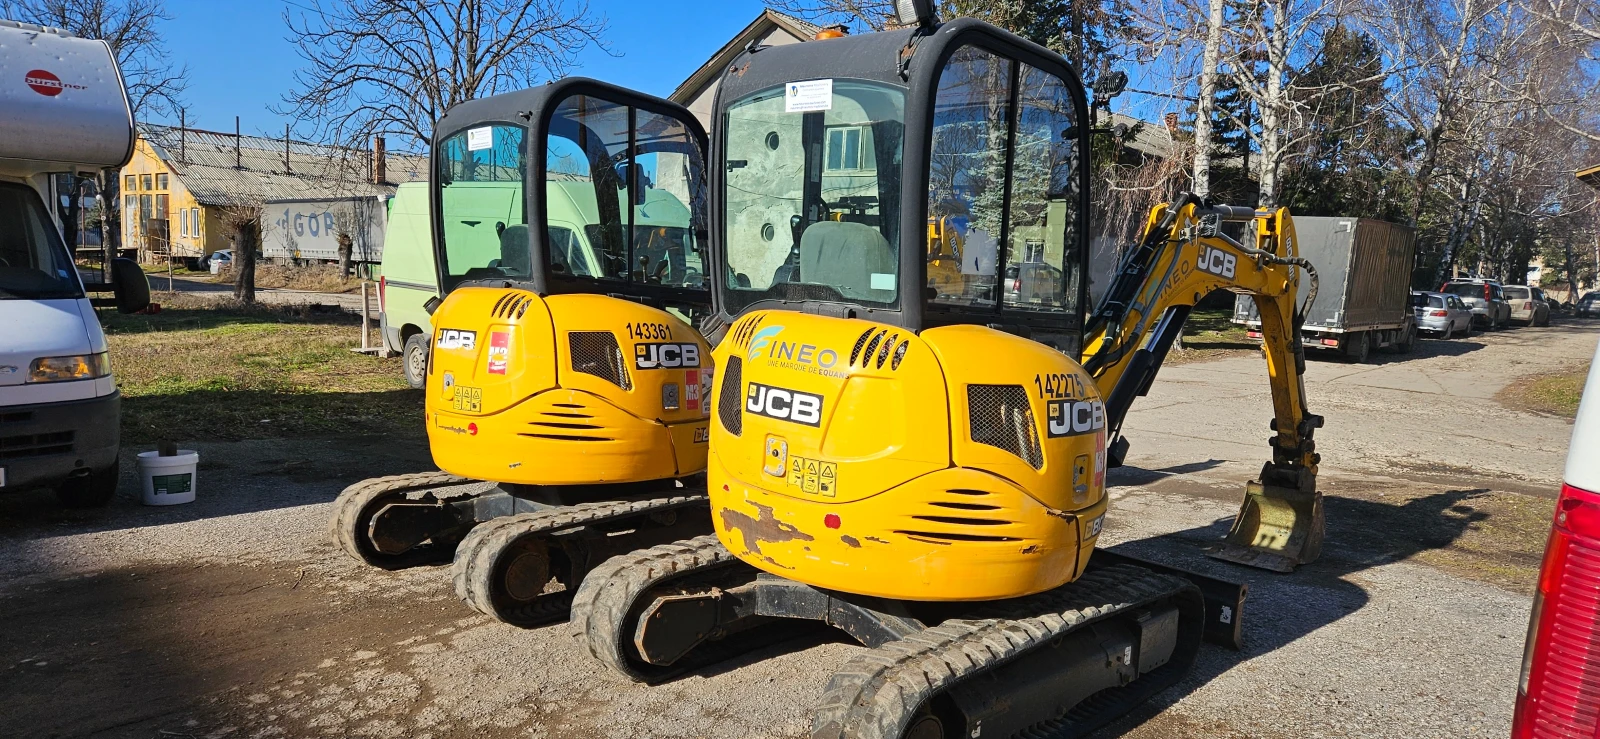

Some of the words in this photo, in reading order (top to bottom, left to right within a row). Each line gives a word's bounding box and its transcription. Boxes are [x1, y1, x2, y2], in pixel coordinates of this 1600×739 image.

[25, 77, 88, 90] bürstner
[1197, 246, 1237, 279] JCB
[626, 322, 673, 340] 143361
[637, 344, 700, 368] JCB
[769, 340, 838, 368] INEO
[767, 360, 779, 368] UNE
[780, 361, 807, 372] MARQUE
[808, 366, 817, 375] DE
[685, 384, 700, 401] M3
[1034, 373, 1085, 399] 142275
[747, 385, 821, 424] JCB
[1049, 400, 1105, 435] JCB
